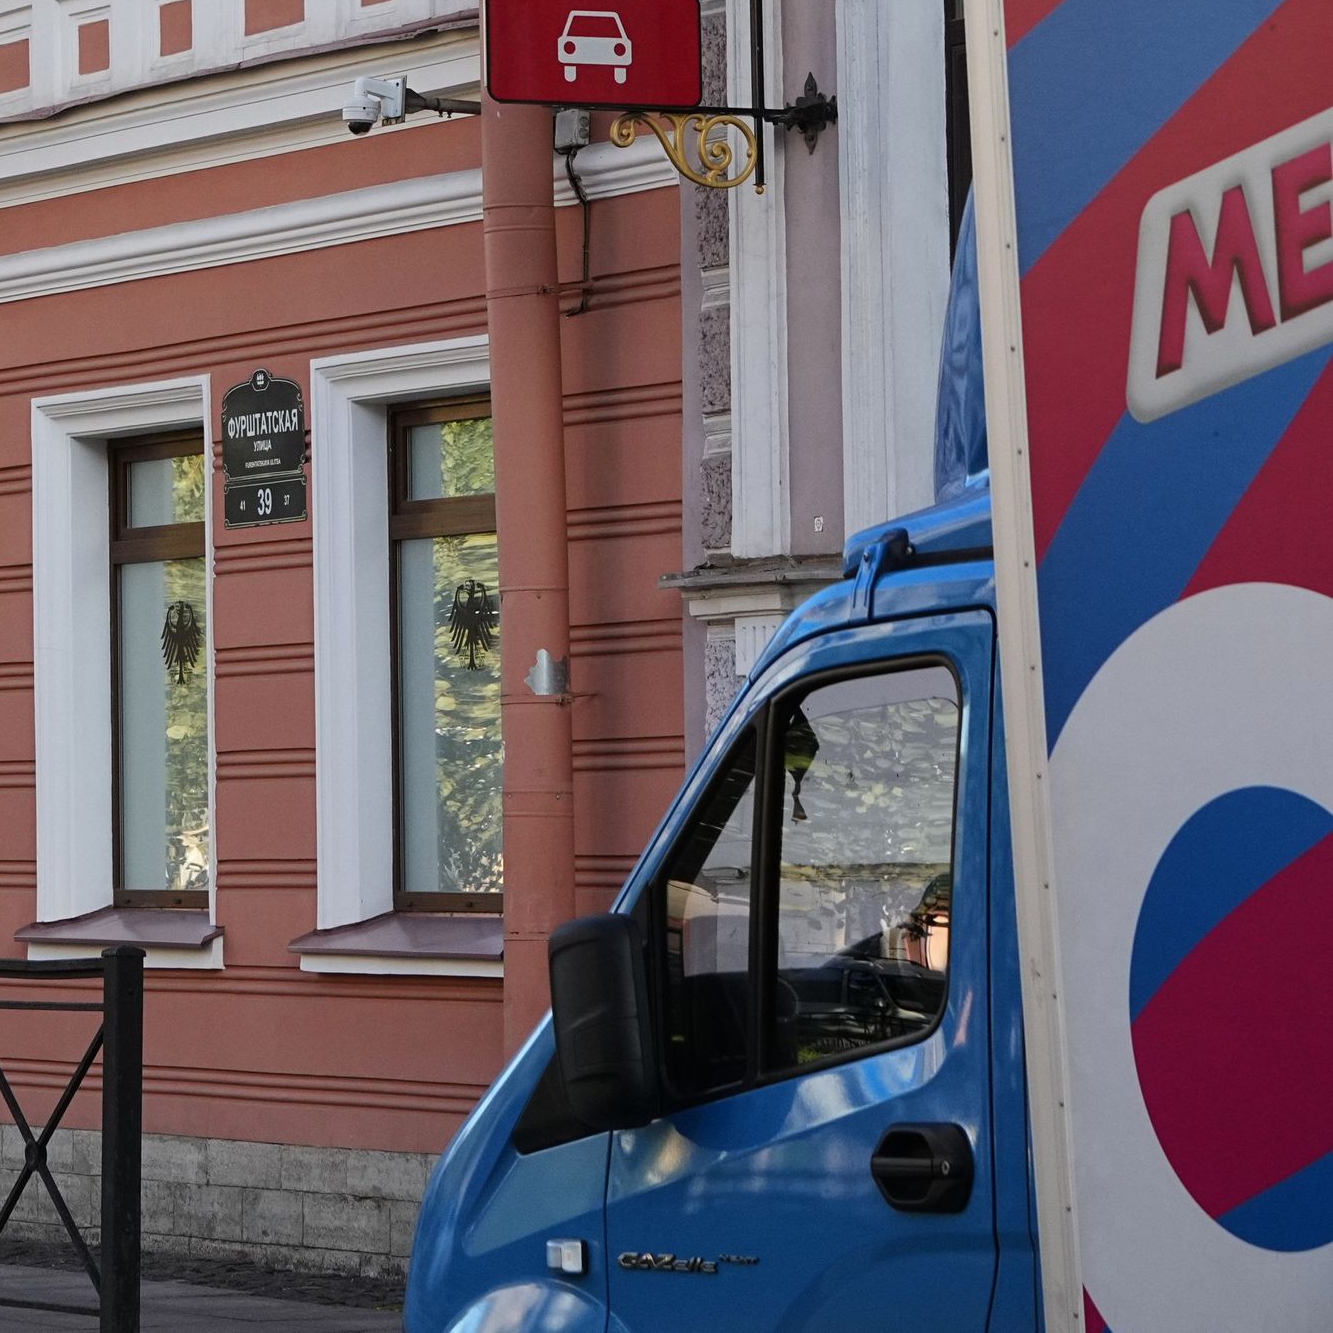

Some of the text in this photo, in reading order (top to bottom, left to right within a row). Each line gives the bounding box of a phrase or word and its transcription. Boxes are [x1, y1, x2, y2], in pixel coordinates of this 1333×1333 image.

[227, 408, 298, 439] ФУРШТАТСКАЯ
[253, 439, 272, 452] УЛИЦА
[257, 488, 272, 515] 39
[284, 494, 290, 506] 37
